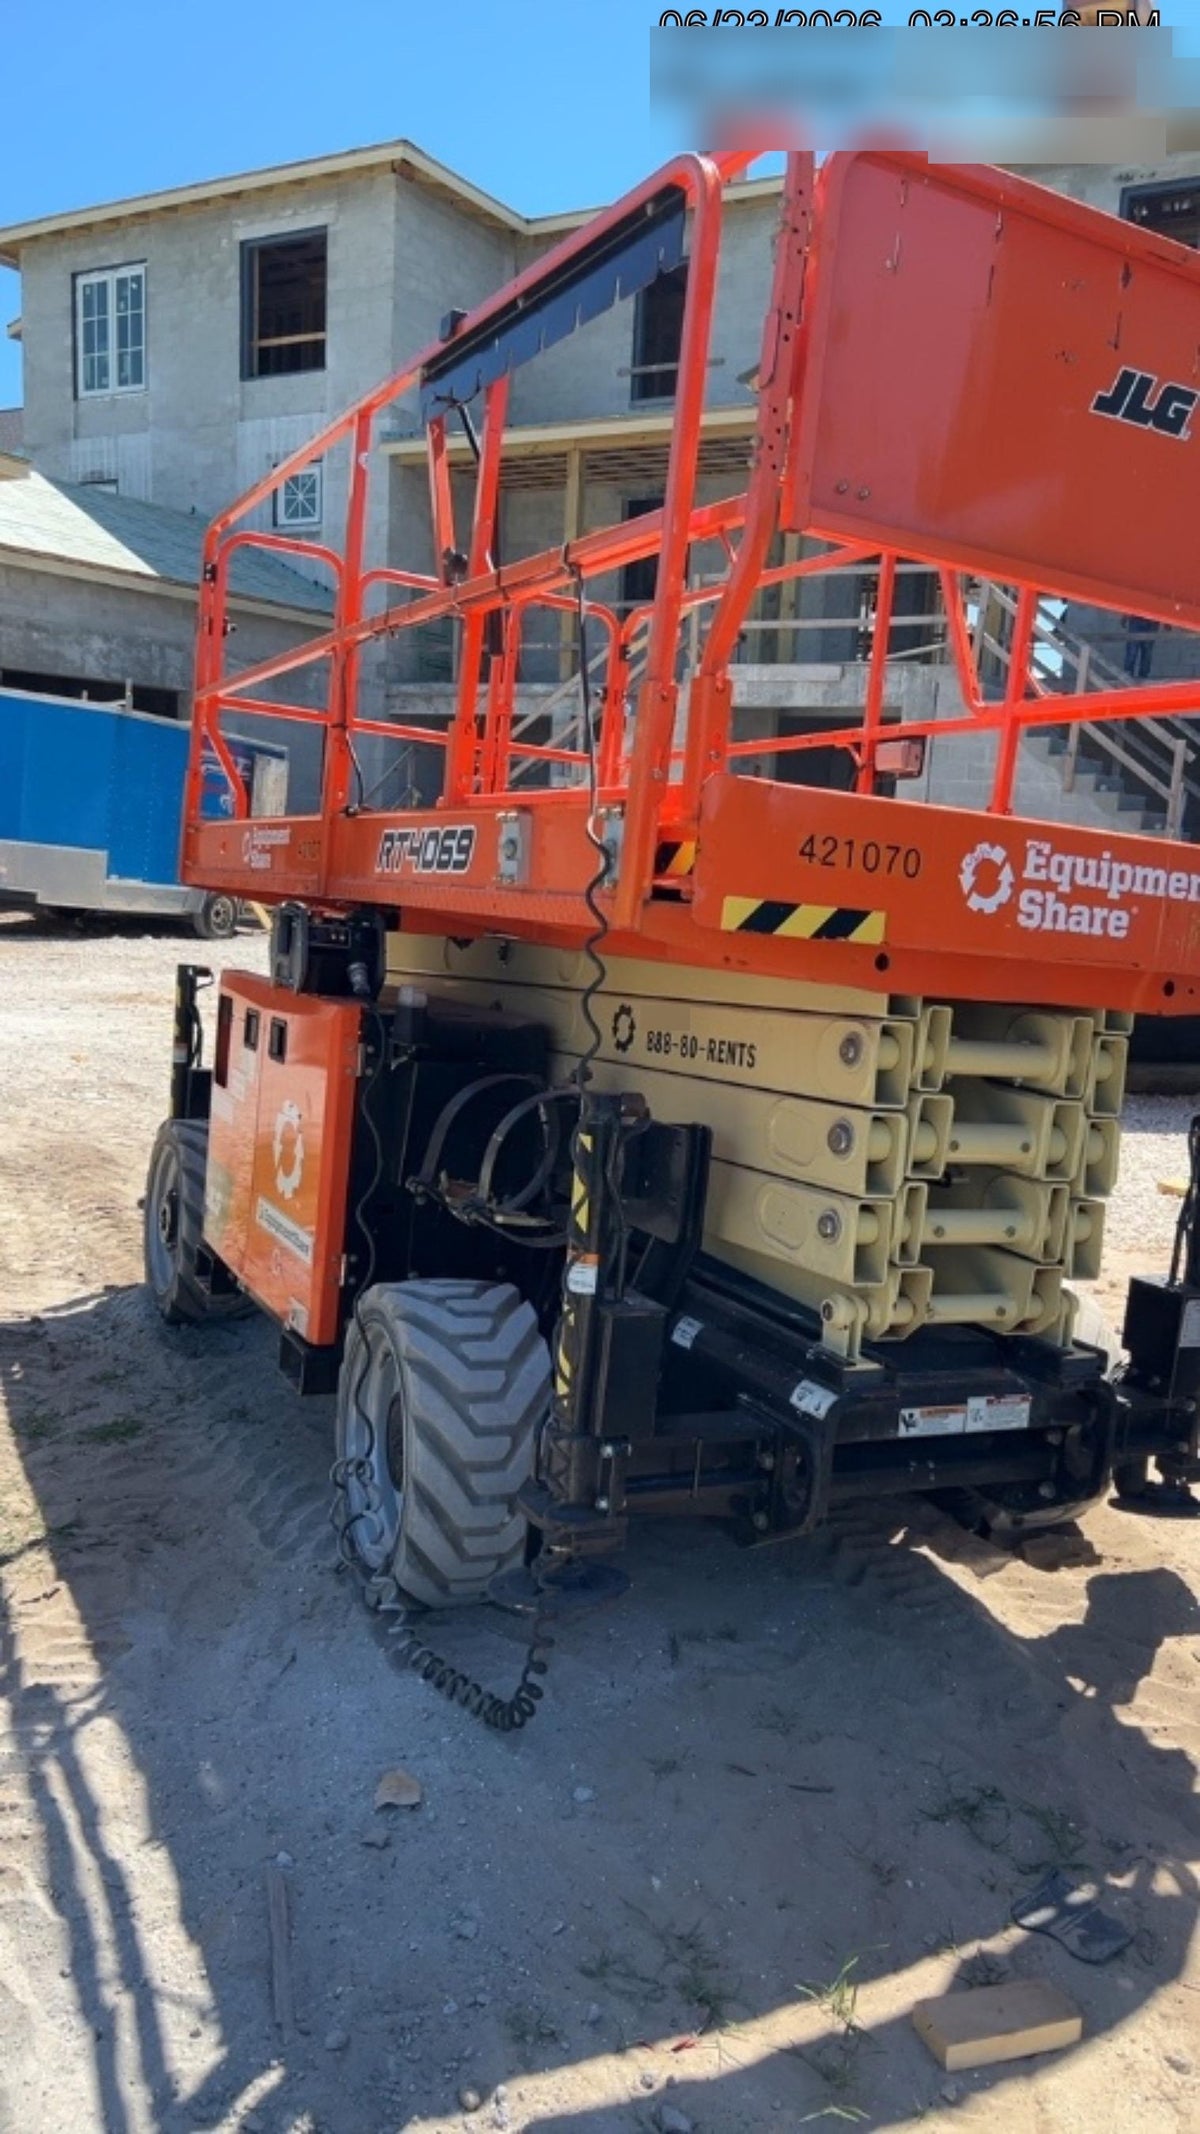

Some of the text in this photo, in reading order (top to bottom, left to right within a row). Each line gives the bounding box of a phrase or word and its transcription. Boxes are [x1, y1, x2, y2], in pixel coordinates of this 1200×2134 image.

[1088, 365, 1200, 441] JLG
[374, 825, 477, 874] RT4069
[800, 833, 922, 879] 421070
[1017, 888, 1130, 939] Share
[646, 1030, 758, 1069] 888-80-RENTS
